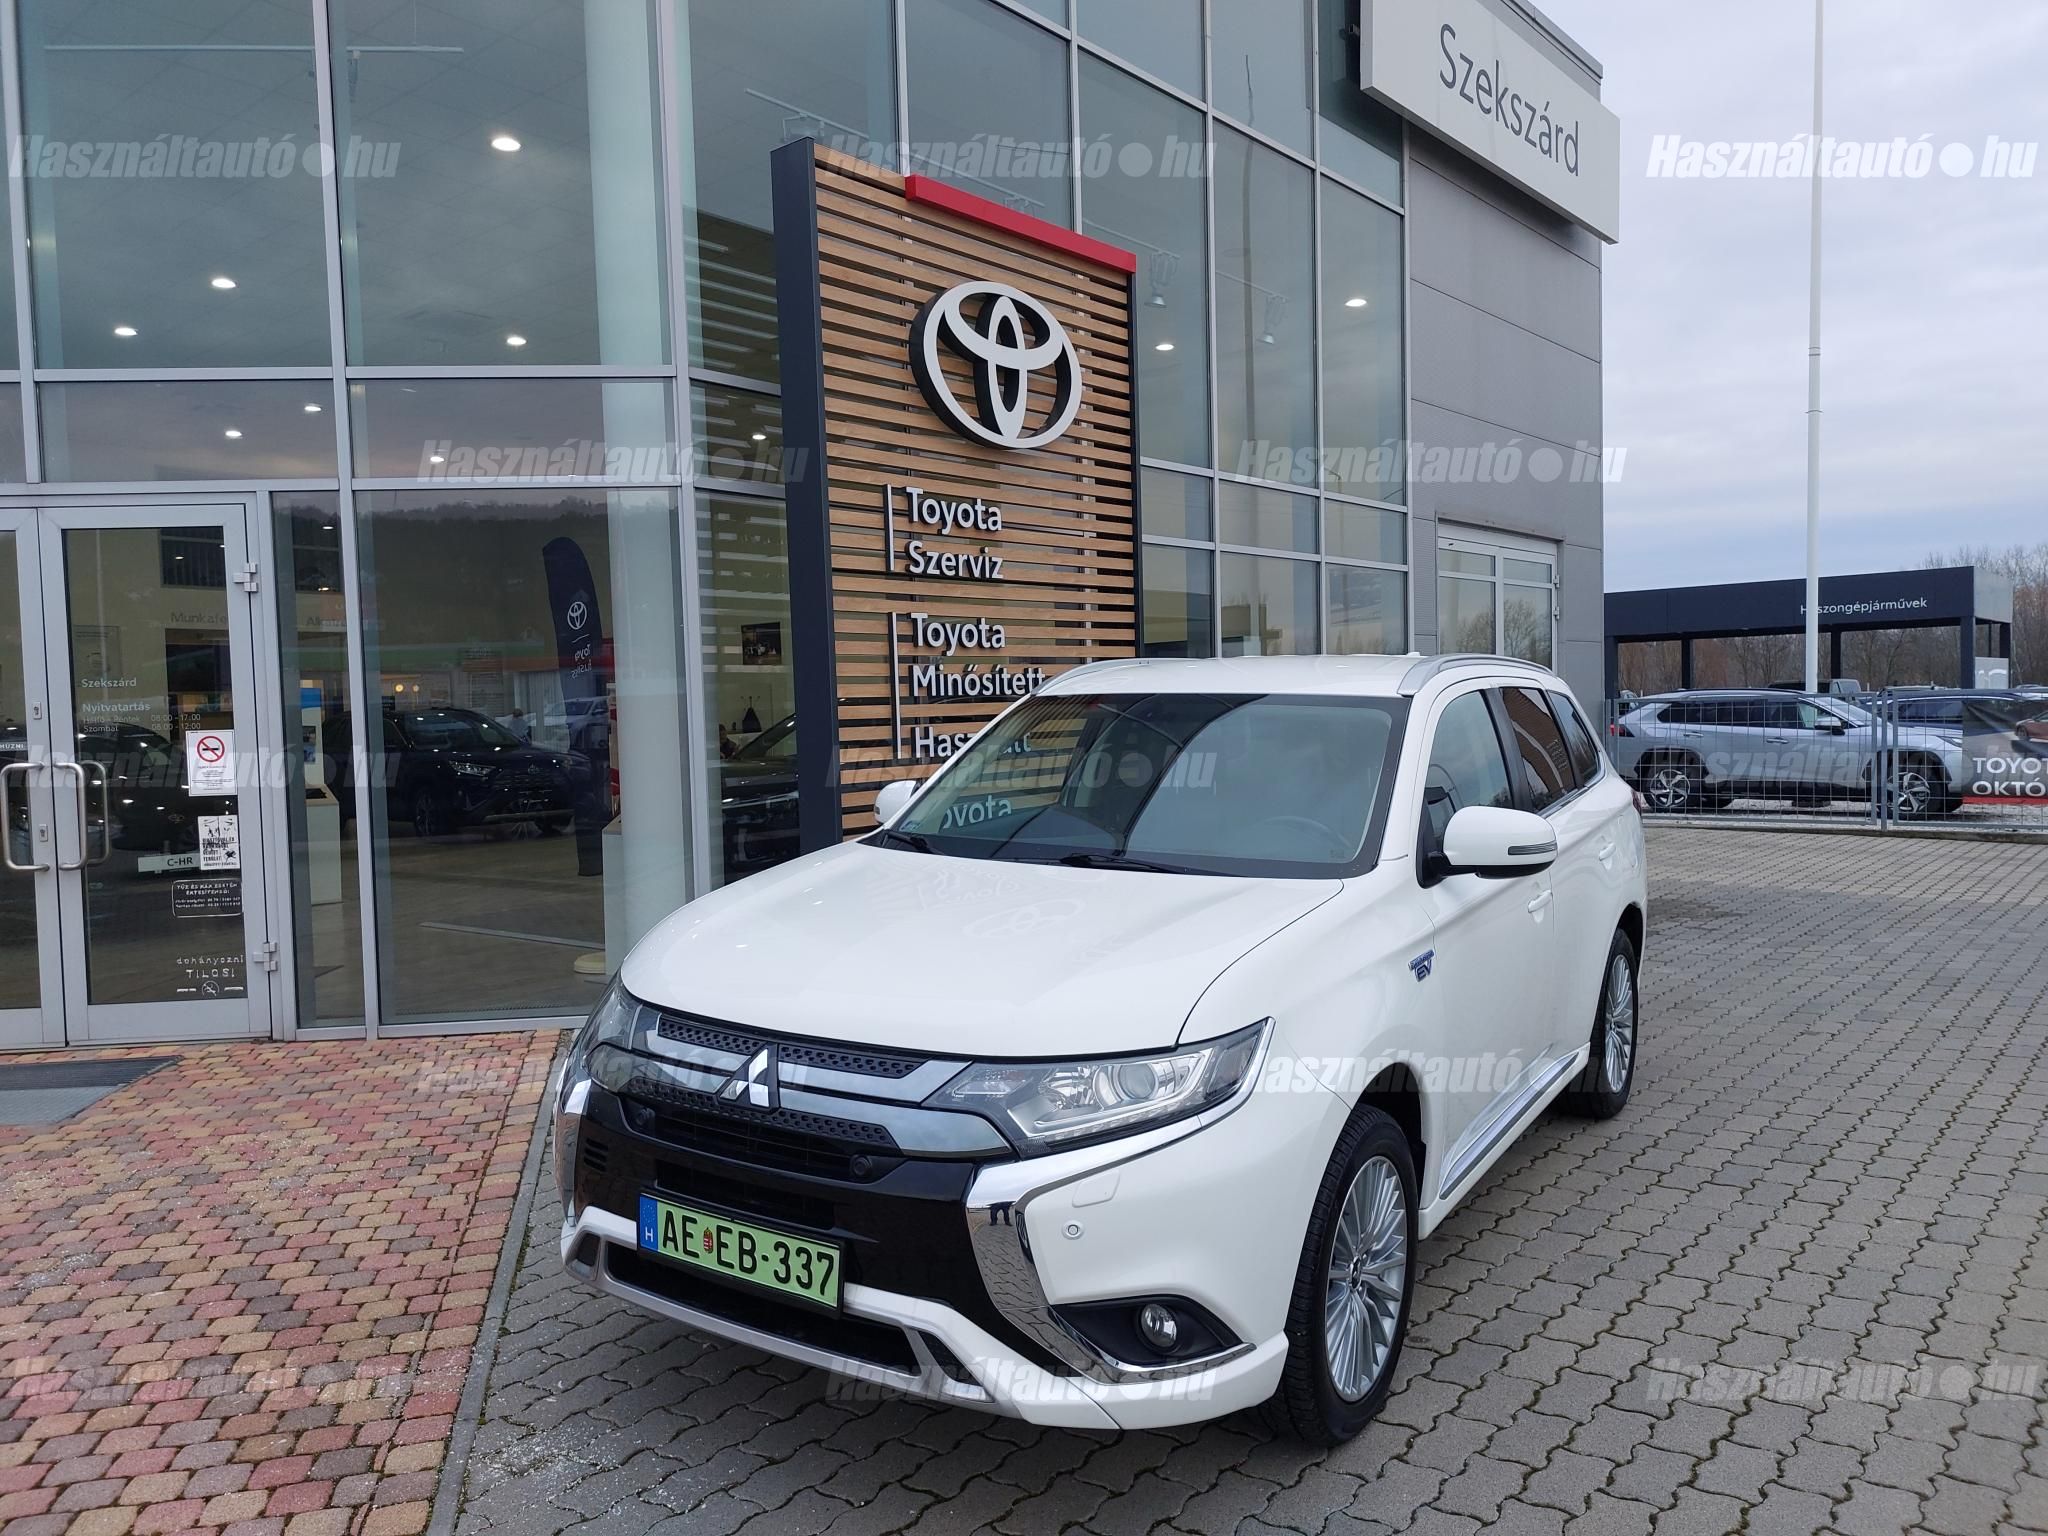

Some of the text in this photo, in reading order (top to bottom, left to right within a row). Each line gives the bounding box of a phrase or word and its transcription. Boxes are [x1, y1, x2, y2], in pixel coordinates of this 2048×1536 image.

[1439, 23, 1579, 176] Szekszárd
[906, 487, 1002, 535] Toyota
[908, 540, 1004, 579] Szerviz
[1800, 597, 1928, 615] Hszongépjárművek
[911, 612, 1005, 656] Toyota
[81, 677, 137, 688] Szekszárd
[912, 664, 1046, 697] Minősített
[82, 702, 151, 714] Nyitvatartás
[167, 857, 193, 867] C-HR
[176, 954, 244, 966] dohányozni
[185, 967, 235, 979] TILOS!
[645, 1228, 654, 1243] H
[716, 1225, 834, 1296] EB-337
